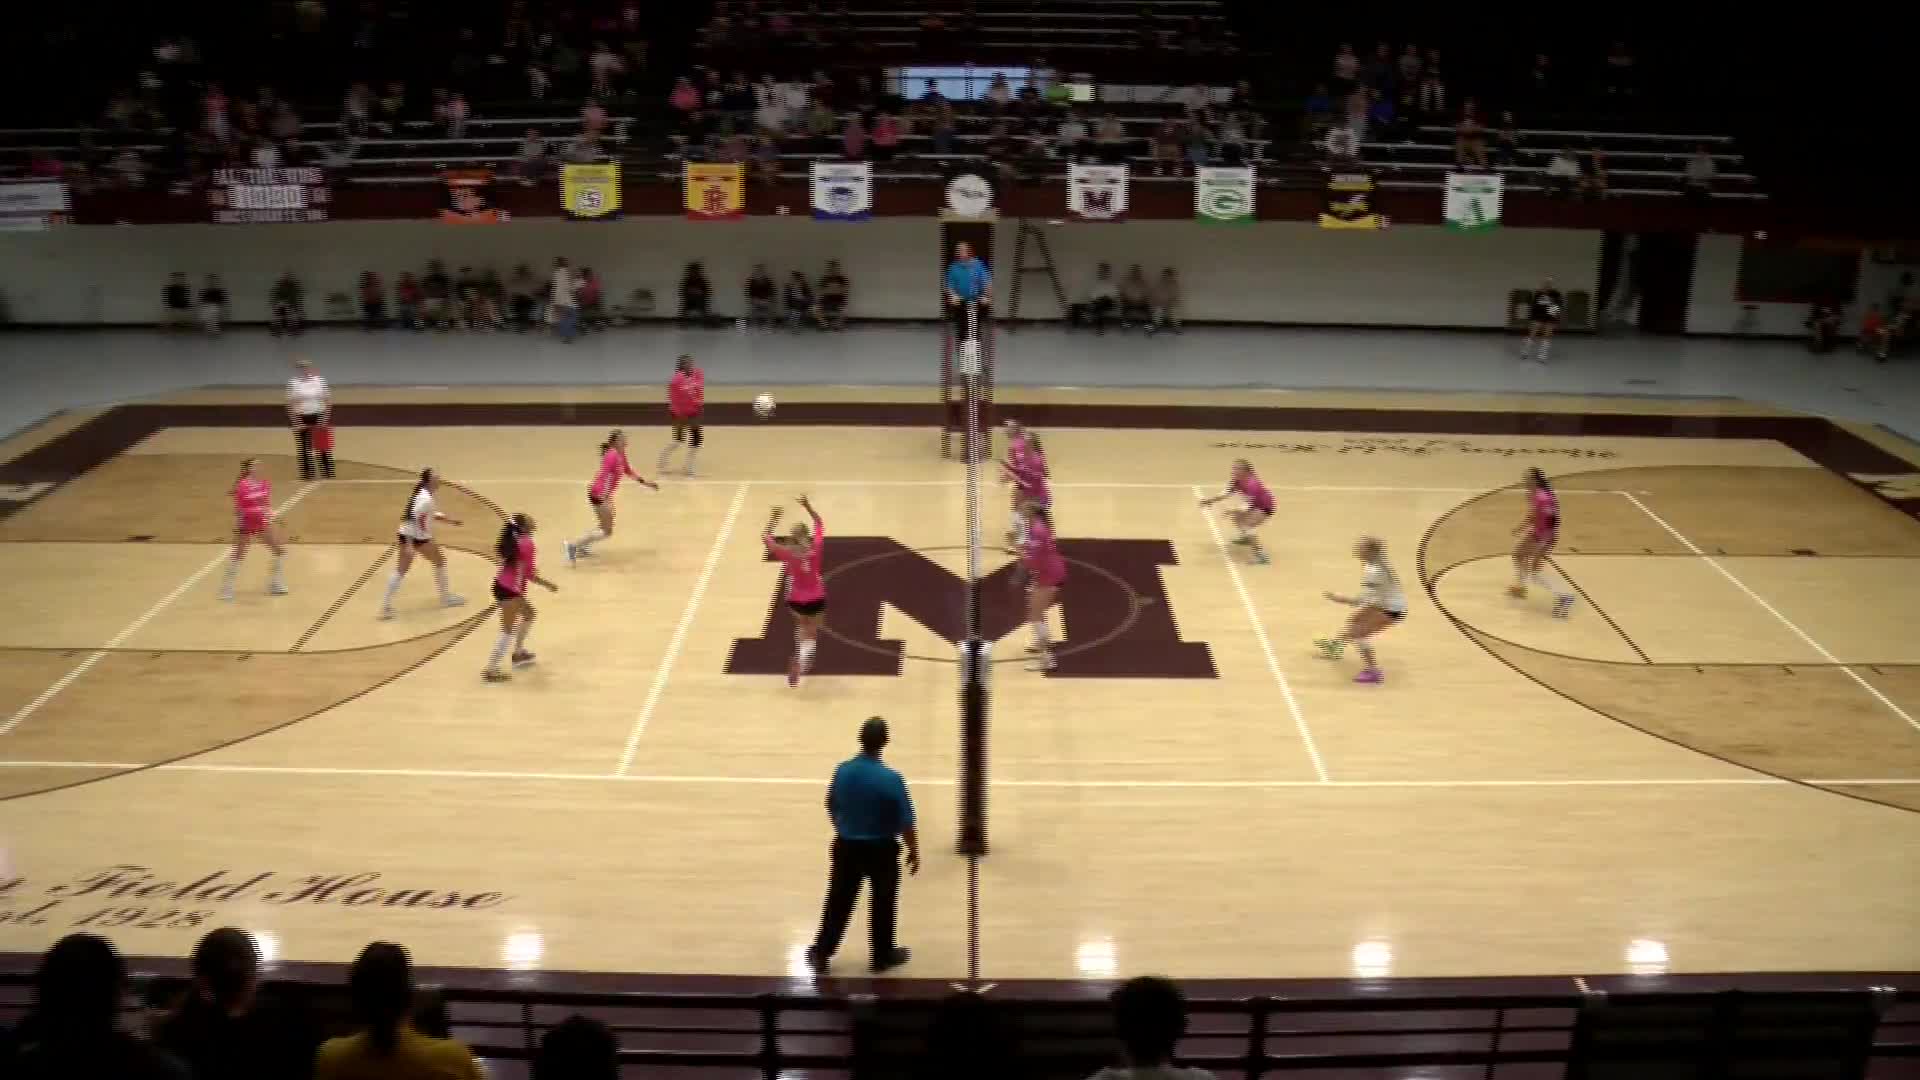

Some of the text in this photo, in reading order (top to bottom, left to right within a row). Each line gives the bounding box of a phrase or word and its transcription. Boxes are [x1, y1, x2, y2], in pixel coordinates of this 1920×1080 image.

[723, 536, 1219, 680] M
[44, 865, 277, 901] Field
[260, 872, 518, 909] House
[68, 907, 216, 928] 1928
